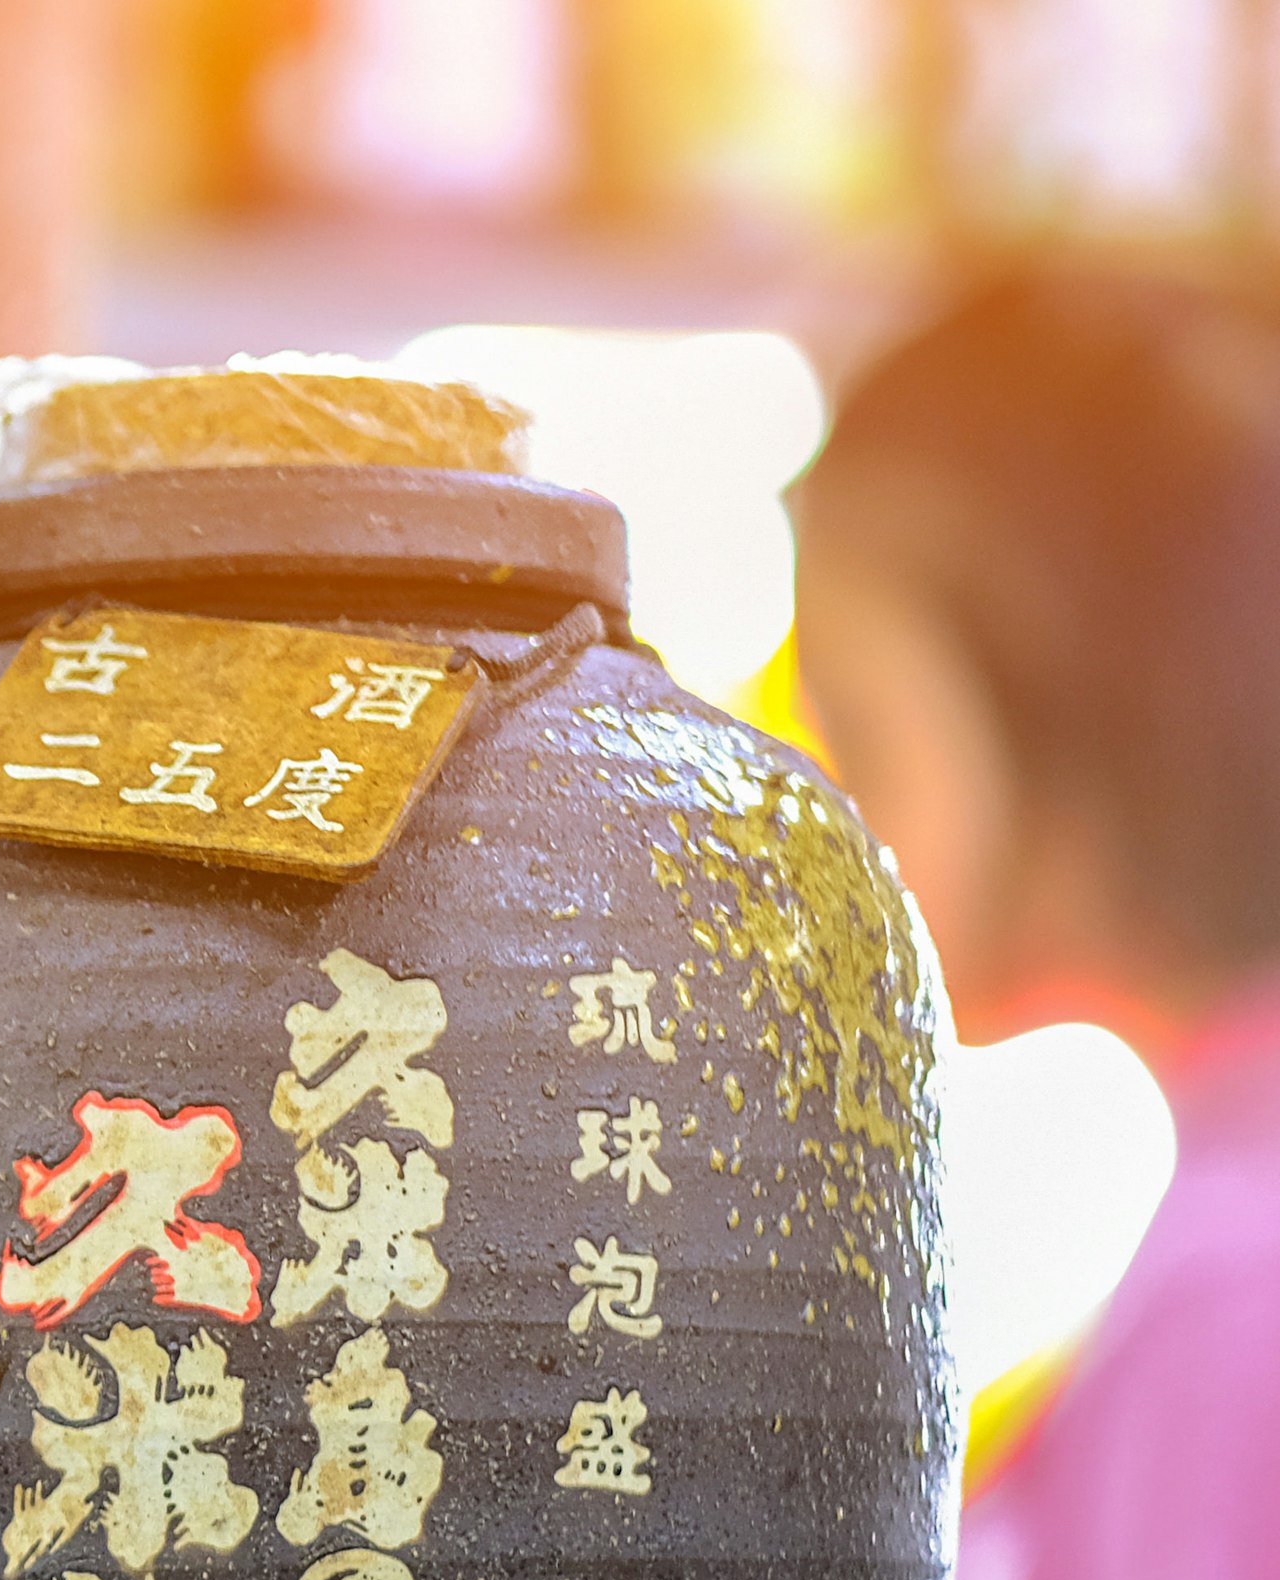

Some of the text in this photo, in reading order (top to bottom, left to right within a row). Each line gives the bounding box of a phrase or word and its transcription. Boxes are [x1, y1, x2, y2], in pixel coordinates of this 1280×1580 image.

[2, 732, 364, 833] 二五度
[552, 956, 678, 1495] 琉球泡盛
